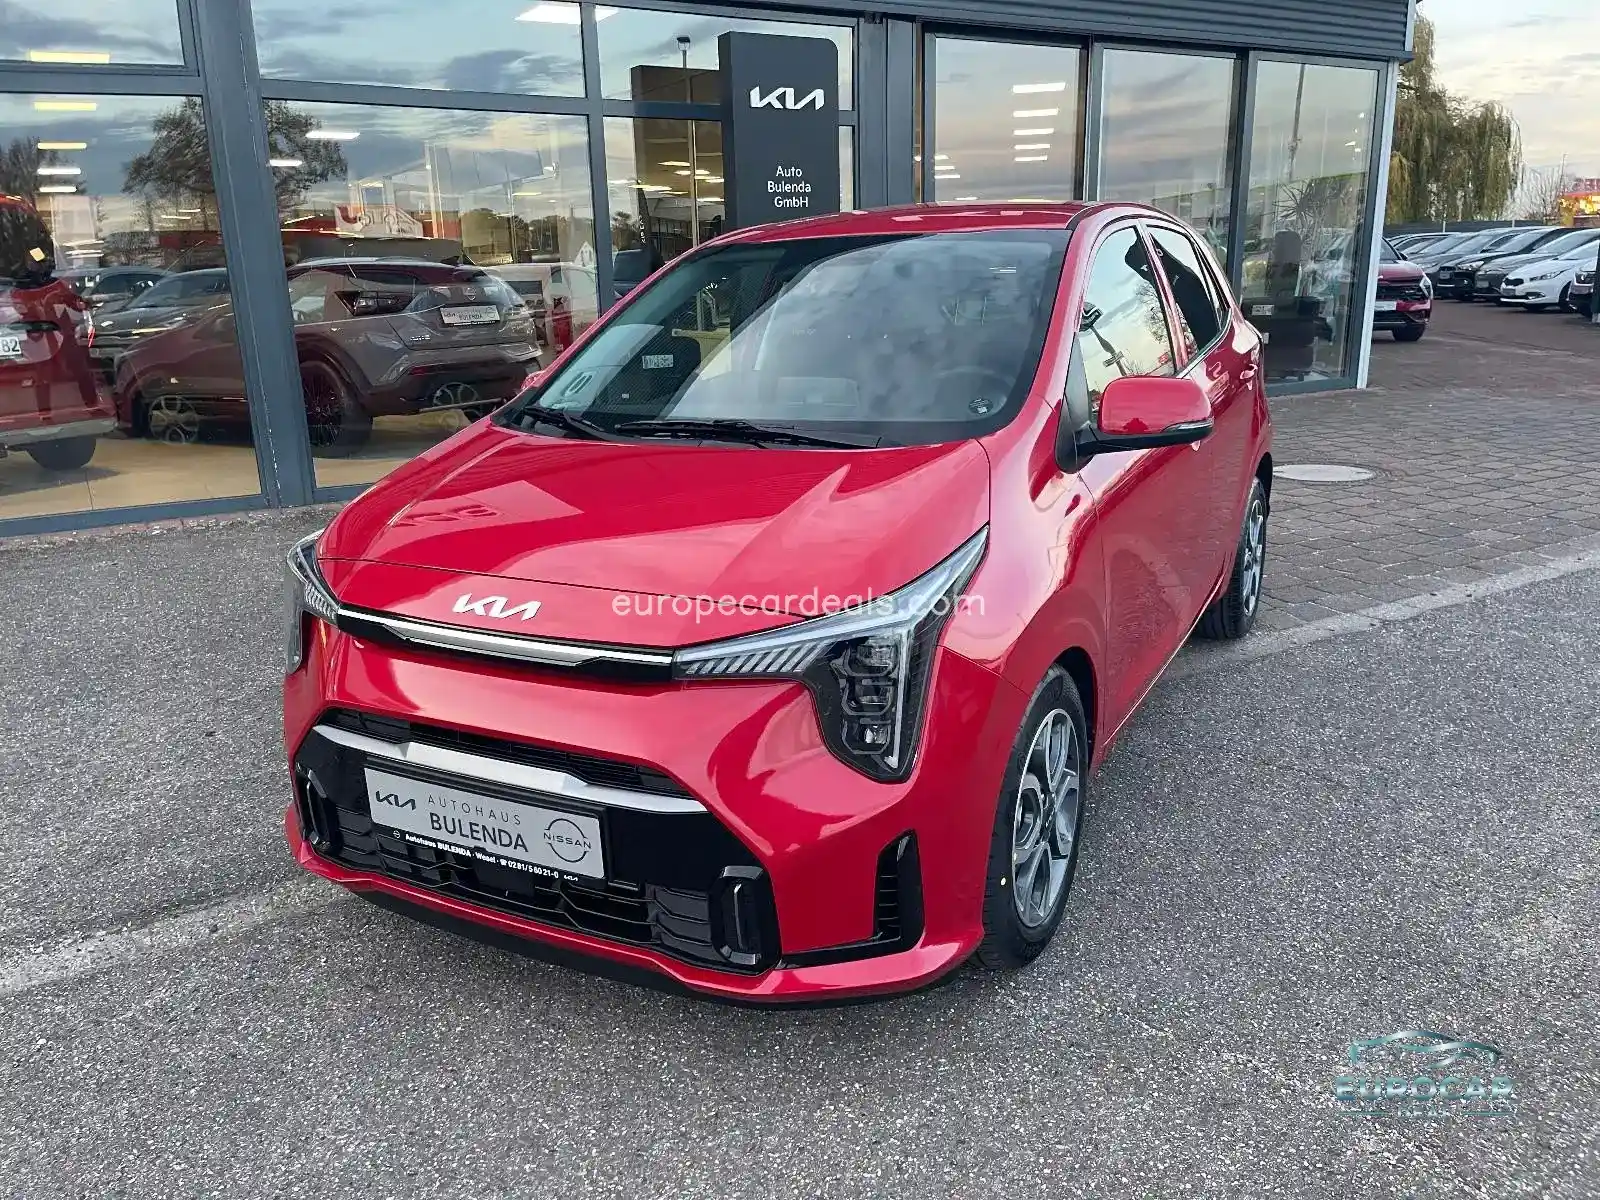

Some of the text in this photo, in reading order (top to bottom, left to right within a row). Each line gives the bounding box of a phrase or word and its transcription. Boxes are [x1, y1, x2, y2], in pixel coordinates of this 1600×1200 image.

[775, 165, 803, 178] Auto
[767, 180, 812, 193] Bulenda
[774, 196, 809, 208] GmbH
[427, 794, 522, 826] AUTOHAUS
[429, 812, 529, 852] BULENDA
[543, 831, 593, 850] NISSAN
[405, 834, 437, 848] Autohaus
[437, 842, 472, 858] BULENDA
[475, 851, 496, 864] Wesel
